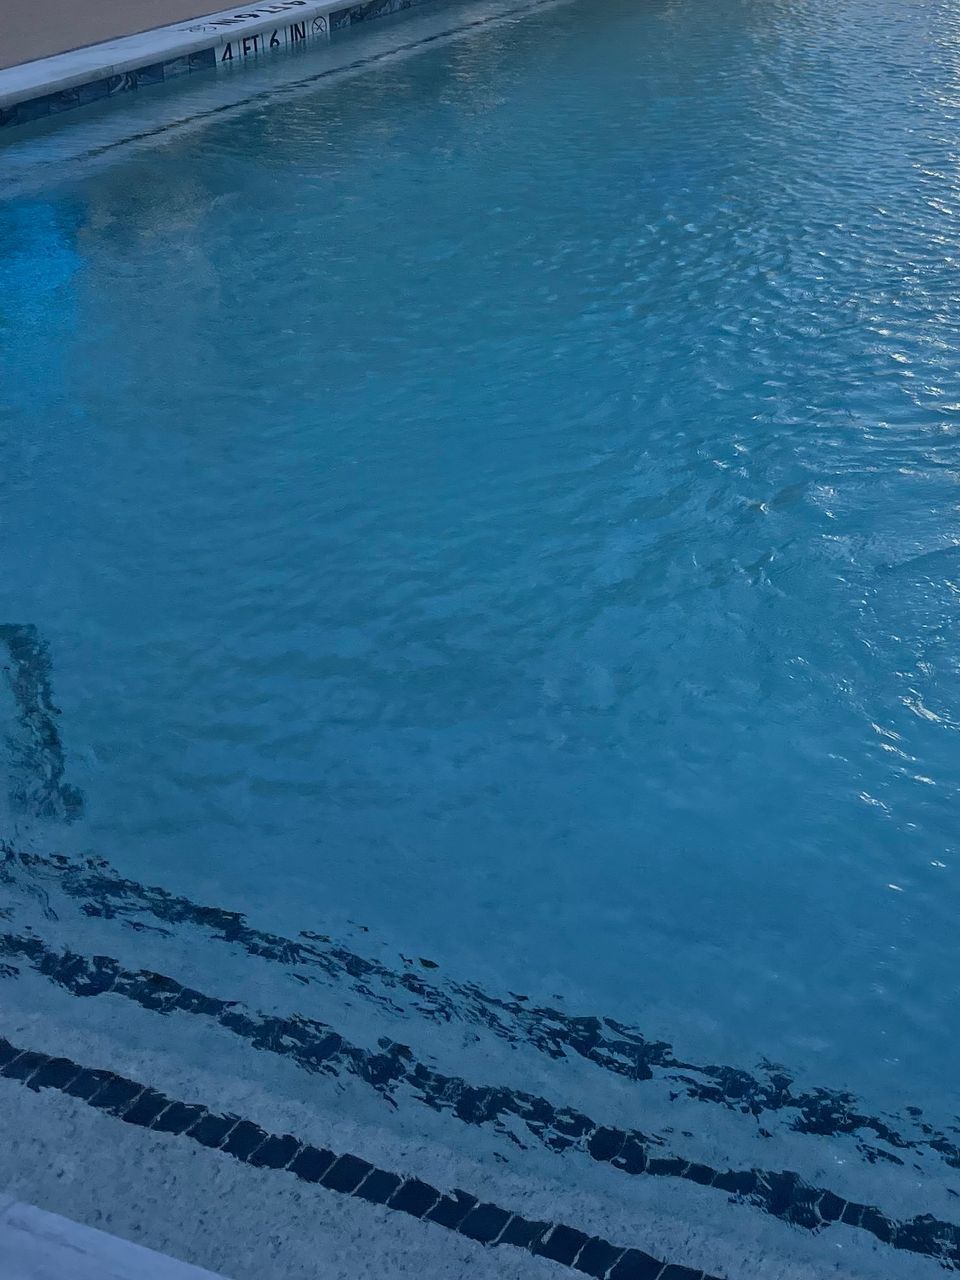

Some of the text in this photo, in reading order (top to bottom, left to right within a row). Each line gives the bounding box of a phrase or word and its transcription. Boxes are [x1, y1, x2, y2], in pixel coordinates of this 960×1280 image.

[221, 21, 306, 62] 4 FT 6 IN
